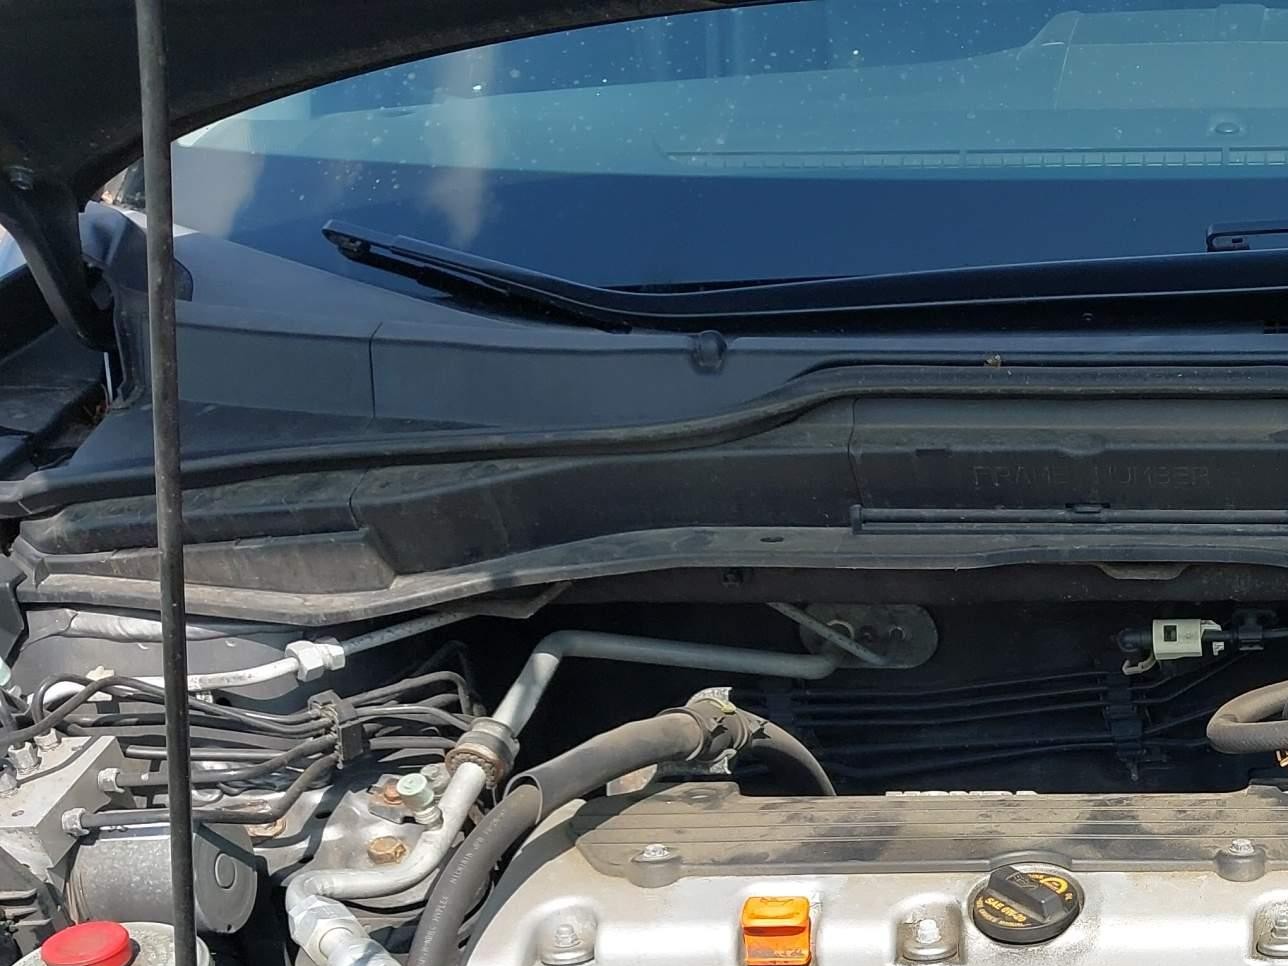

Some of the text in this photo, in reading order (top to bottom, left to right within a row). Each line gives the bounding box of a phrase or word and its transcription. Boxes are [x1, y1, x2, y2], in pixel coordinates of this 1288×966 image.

[972, 465, 1211, 487] FRAME NUMBER
[984, 896, 1004, 911] SAE
